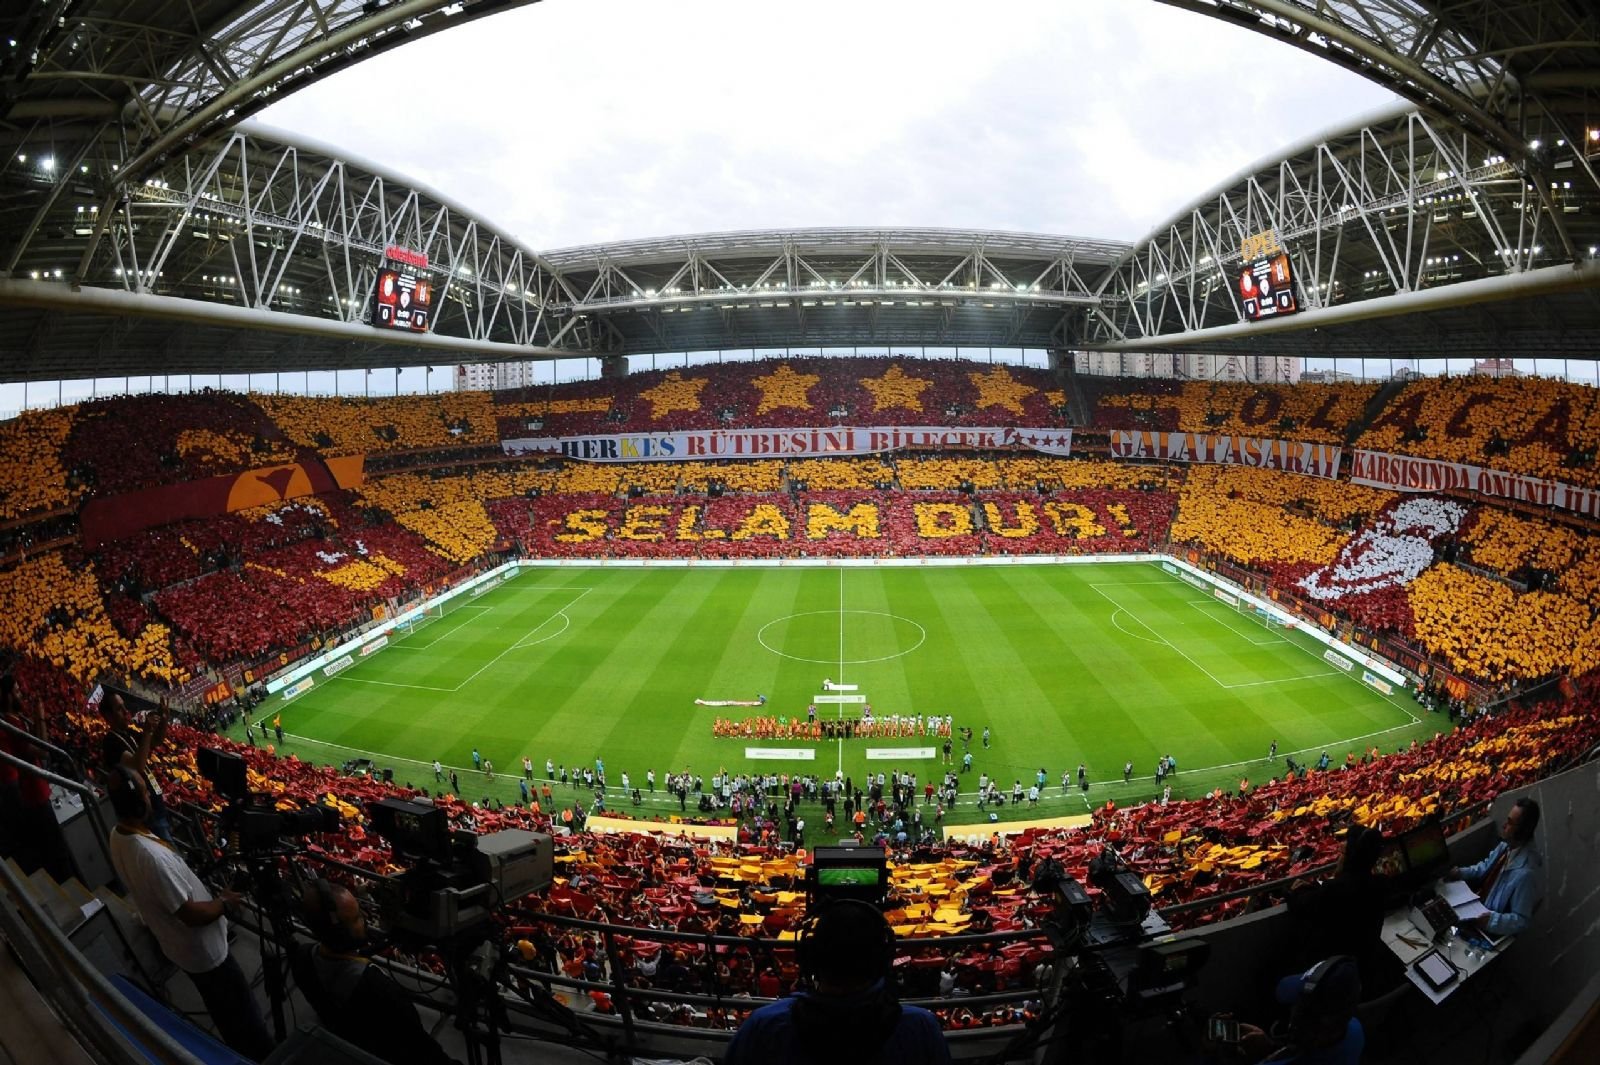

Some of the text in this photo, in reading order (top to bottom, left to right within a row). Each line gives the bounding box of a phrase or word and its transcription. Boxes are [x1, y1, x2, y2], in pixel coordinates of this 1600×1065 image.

[1248, 302, 1254, 313] 0
[1281, 295, 1288, 307] 0
[383, 308, 389, 320] 0
[417, 314, 423, 326] 0
[561, 438, 676, 459] HERKES
[687, 427, 855, 456] RÜTBESİNİ
[1111, 430, 1340, 479] GALATASARAY
[1352, 452, 1470, 490] KARŞISINDA
[1477, 468, 1557, 505] ÖNÜNÜ
[550, 500, 1137, 543] SELAM DUR!
